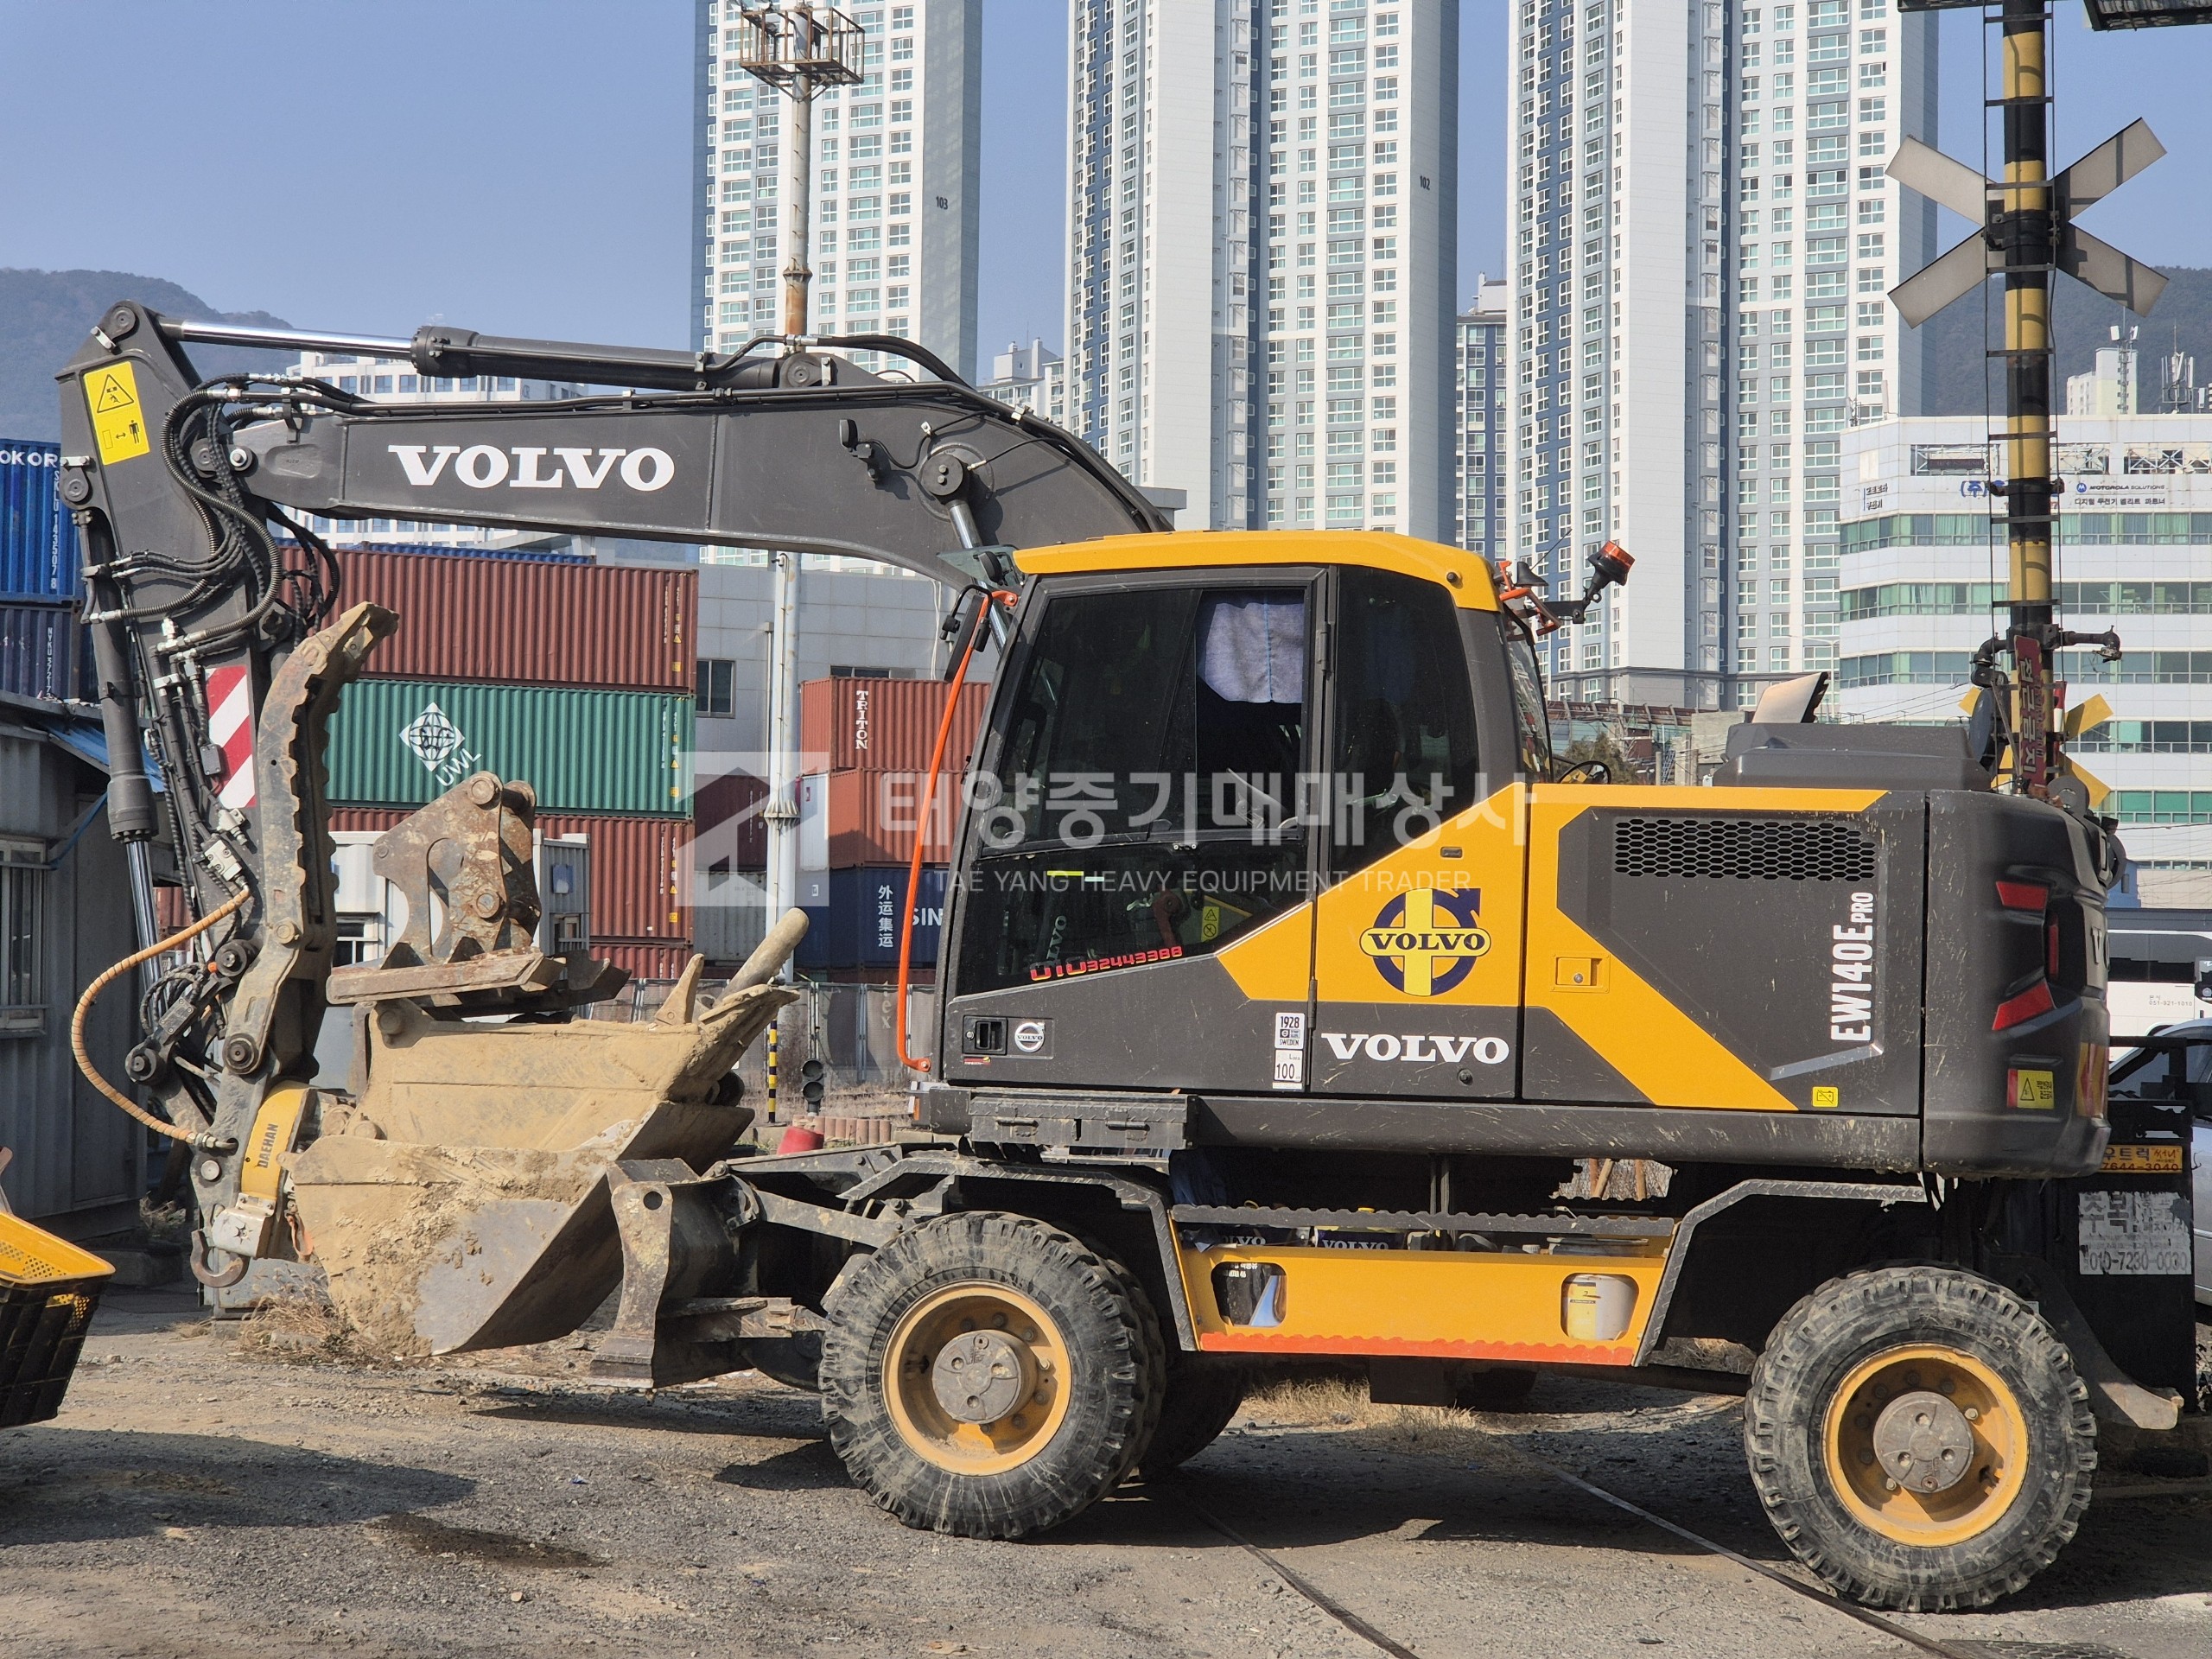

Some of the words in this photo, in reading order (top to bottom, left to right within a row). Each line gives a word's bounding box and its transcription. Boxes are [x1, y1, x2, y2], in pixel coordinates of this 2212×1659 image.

[1420, 175, 1430, 190] 102
[936, 196, 948, 210] 103
[388, 444, 675, 490] VOLVO
[855, 690, 869, 749] TRITON
[2020, 663, 2037, 772] 접근금지
[435, 748, 481, 785] UWL
[878, 885, 893, 948] 外运集运
[1851, 892, 1874, 923] PRO
[1367, 932, 1485, 951] VOLVO
[1831, 925, 1873, 1041] EW140E
[1281, 1016, 1300, 1028] 1928
[1322, 1033, 1510, 1065] VOLVO
[1276, 1064, 1295, 1079] 100
[257, 1124, 278, 1168] DAEHAN
[2101, 1162, 2179, 1171] 7644-3040
[1322, 1239, 1389, 1249] VOLVO
